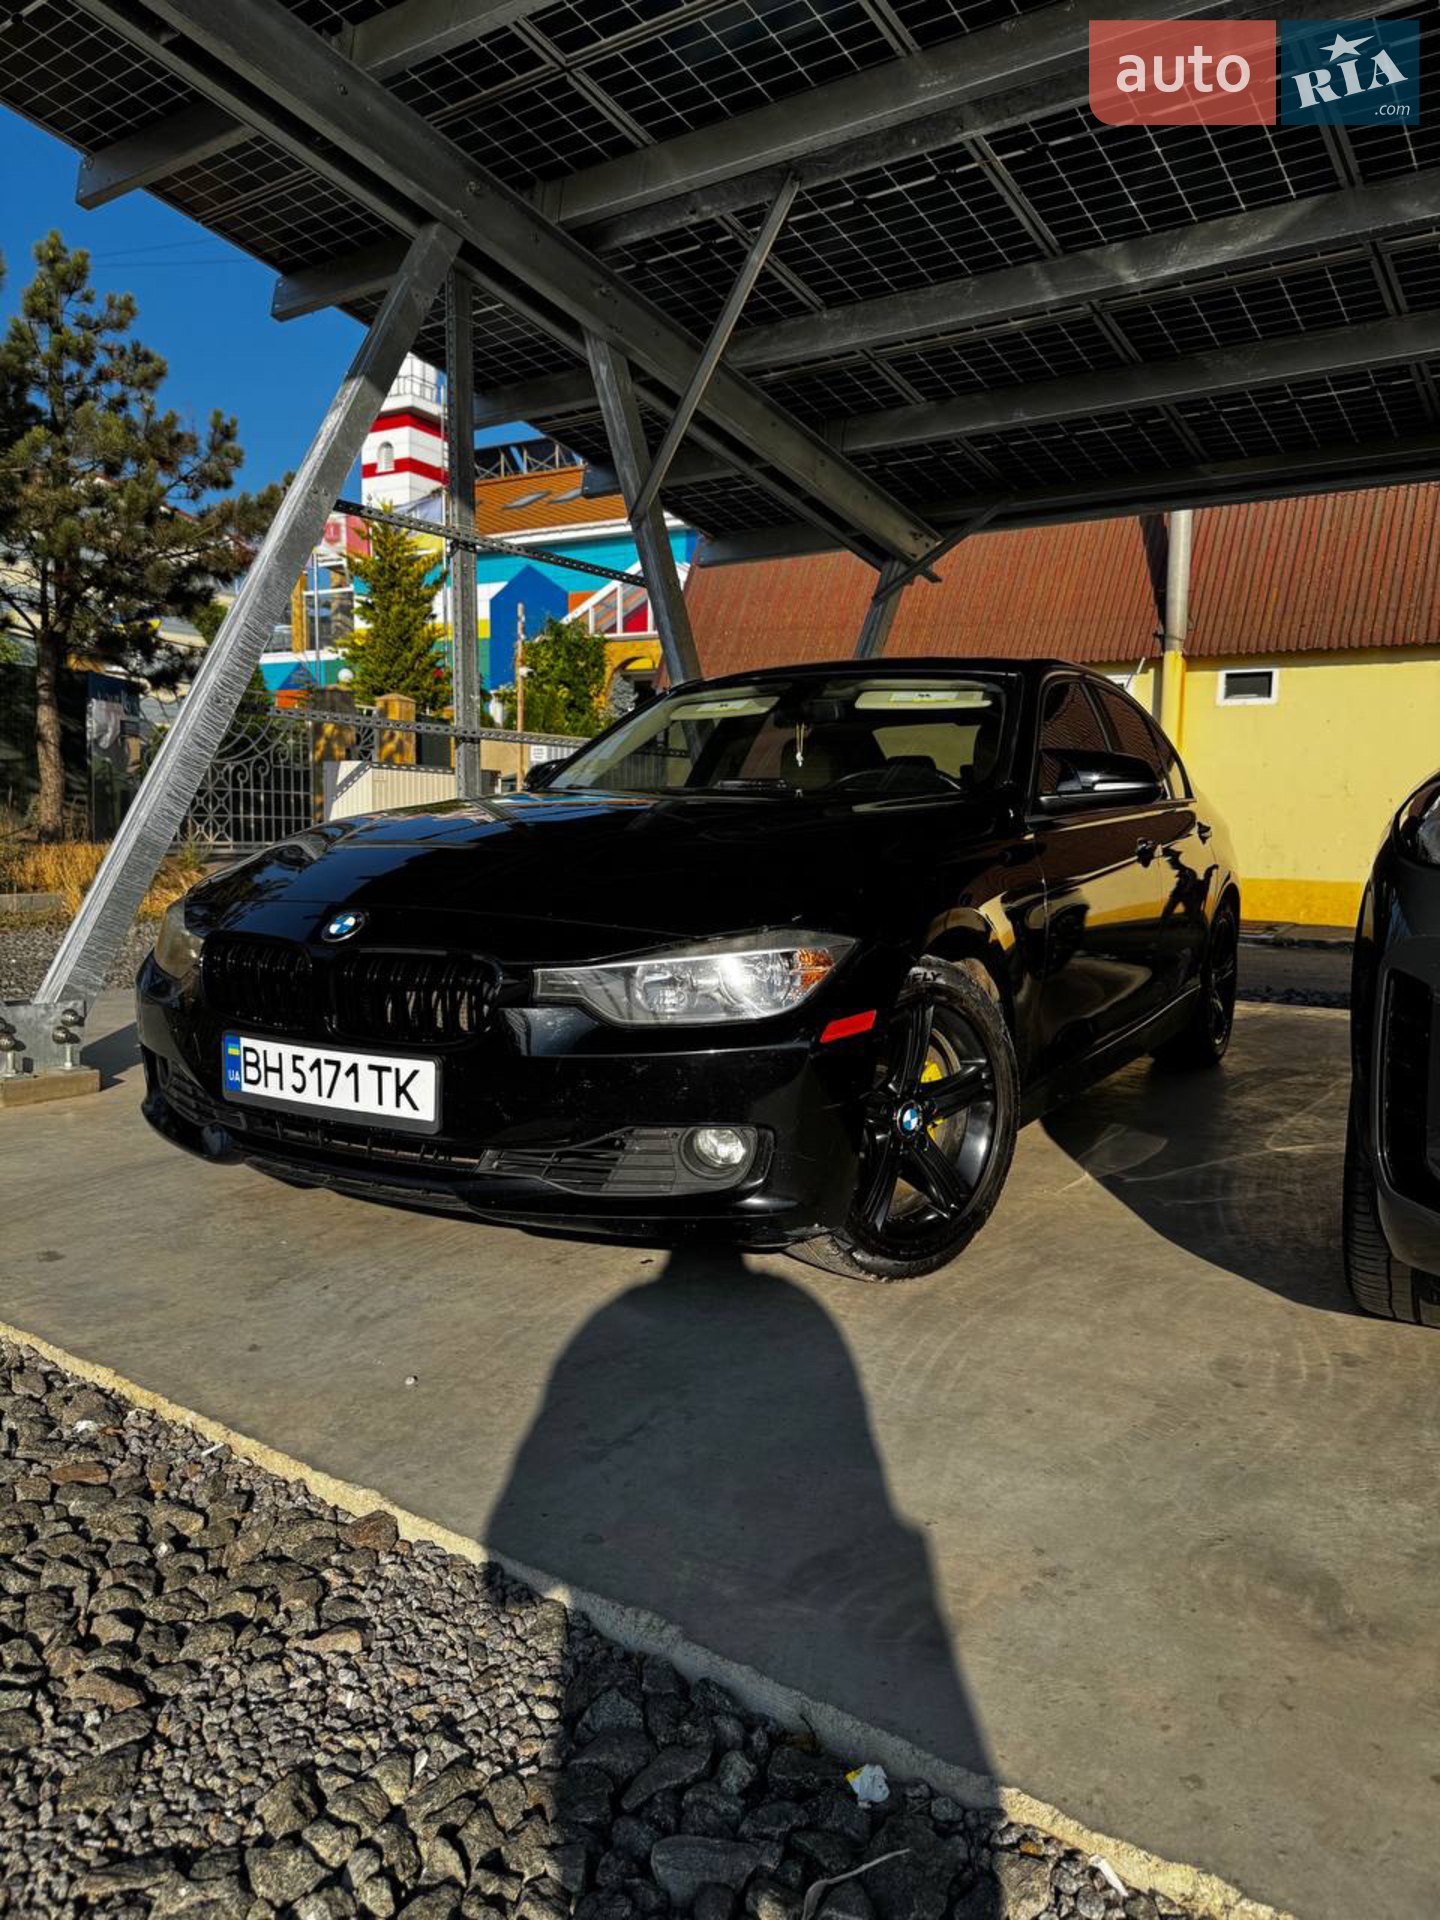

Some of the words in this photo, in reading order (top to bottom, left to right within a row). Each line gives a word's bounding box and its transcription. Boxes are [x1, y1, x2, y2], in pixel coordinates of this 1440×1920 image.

[228, 1069, 241, 1083] UA
[243, 1046, 284, 1091] BH
[291, 1054, 360, 1103] 5171
[368, 1063, 421, 1112] TK
